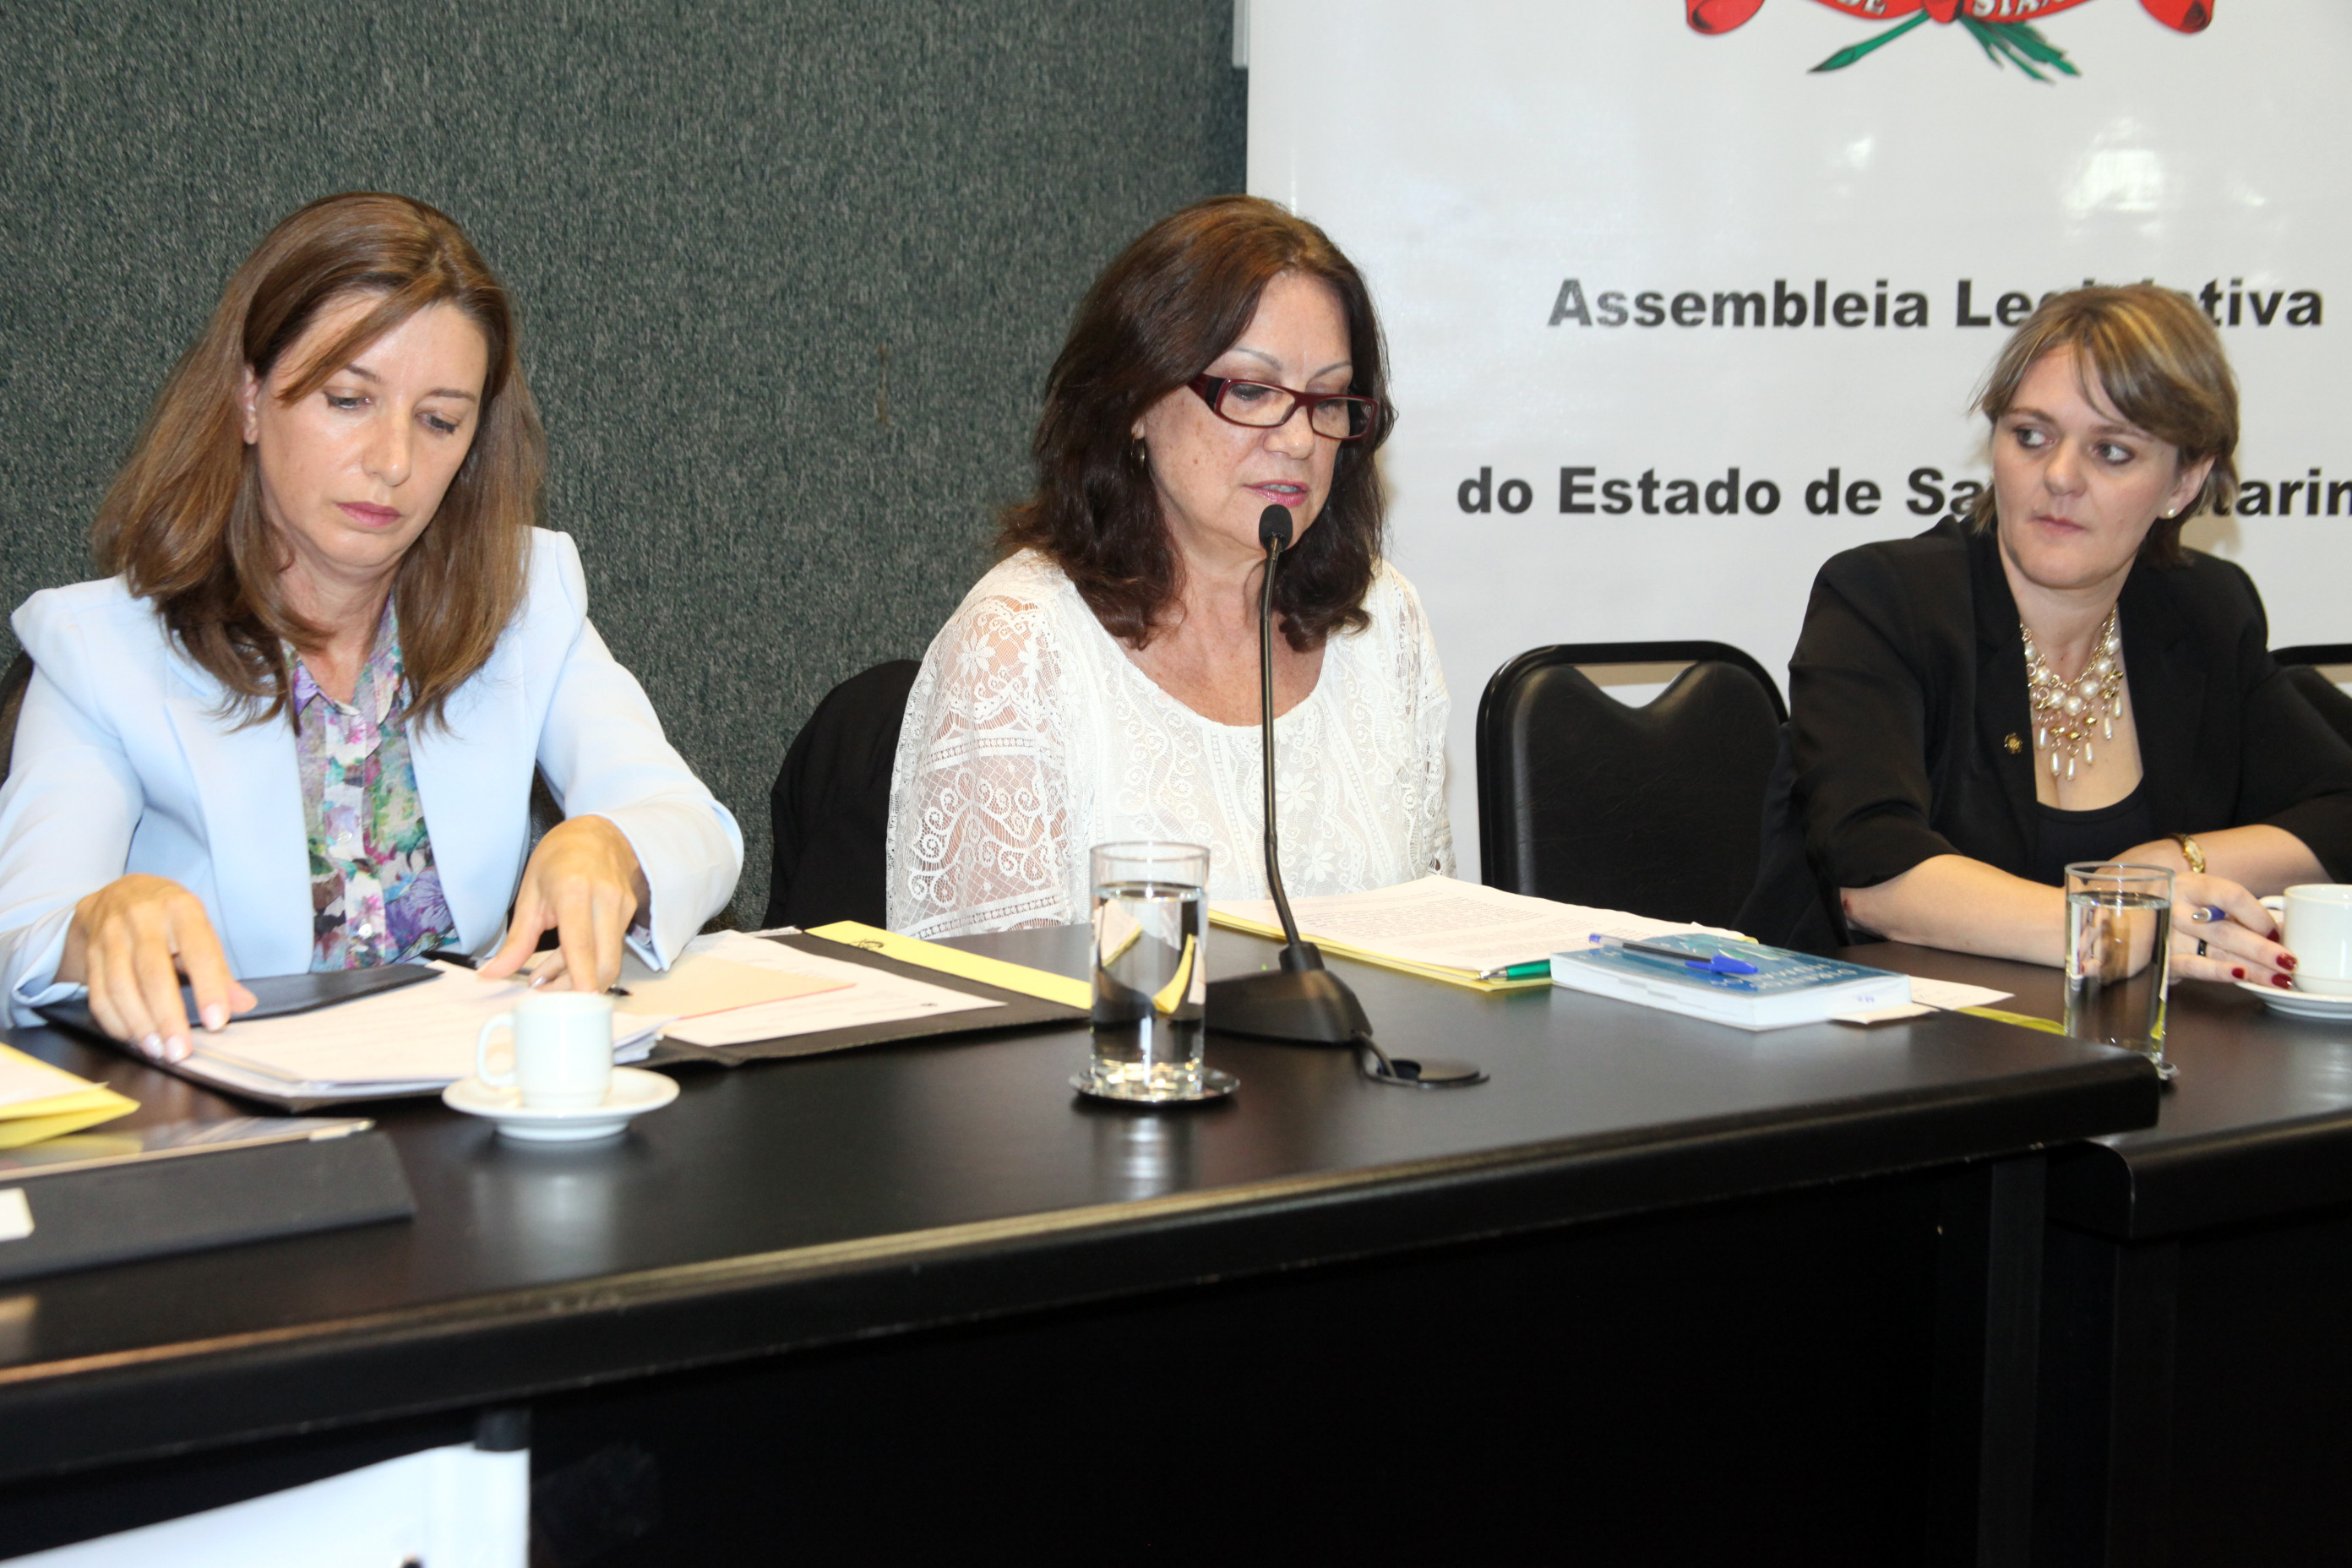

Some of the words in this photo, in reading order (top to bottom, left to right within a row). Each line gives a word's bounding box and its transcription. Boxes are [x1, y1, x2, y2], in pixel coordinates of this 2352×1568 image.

[1548, 278, 1929, 328] Assembleia
[1955, 277, 2323, 327] Letiva
[1456, 466, 1533, 515] do
[1558, 466, 1781, 515] Estado
[1805, 466, 1881, 515] de
